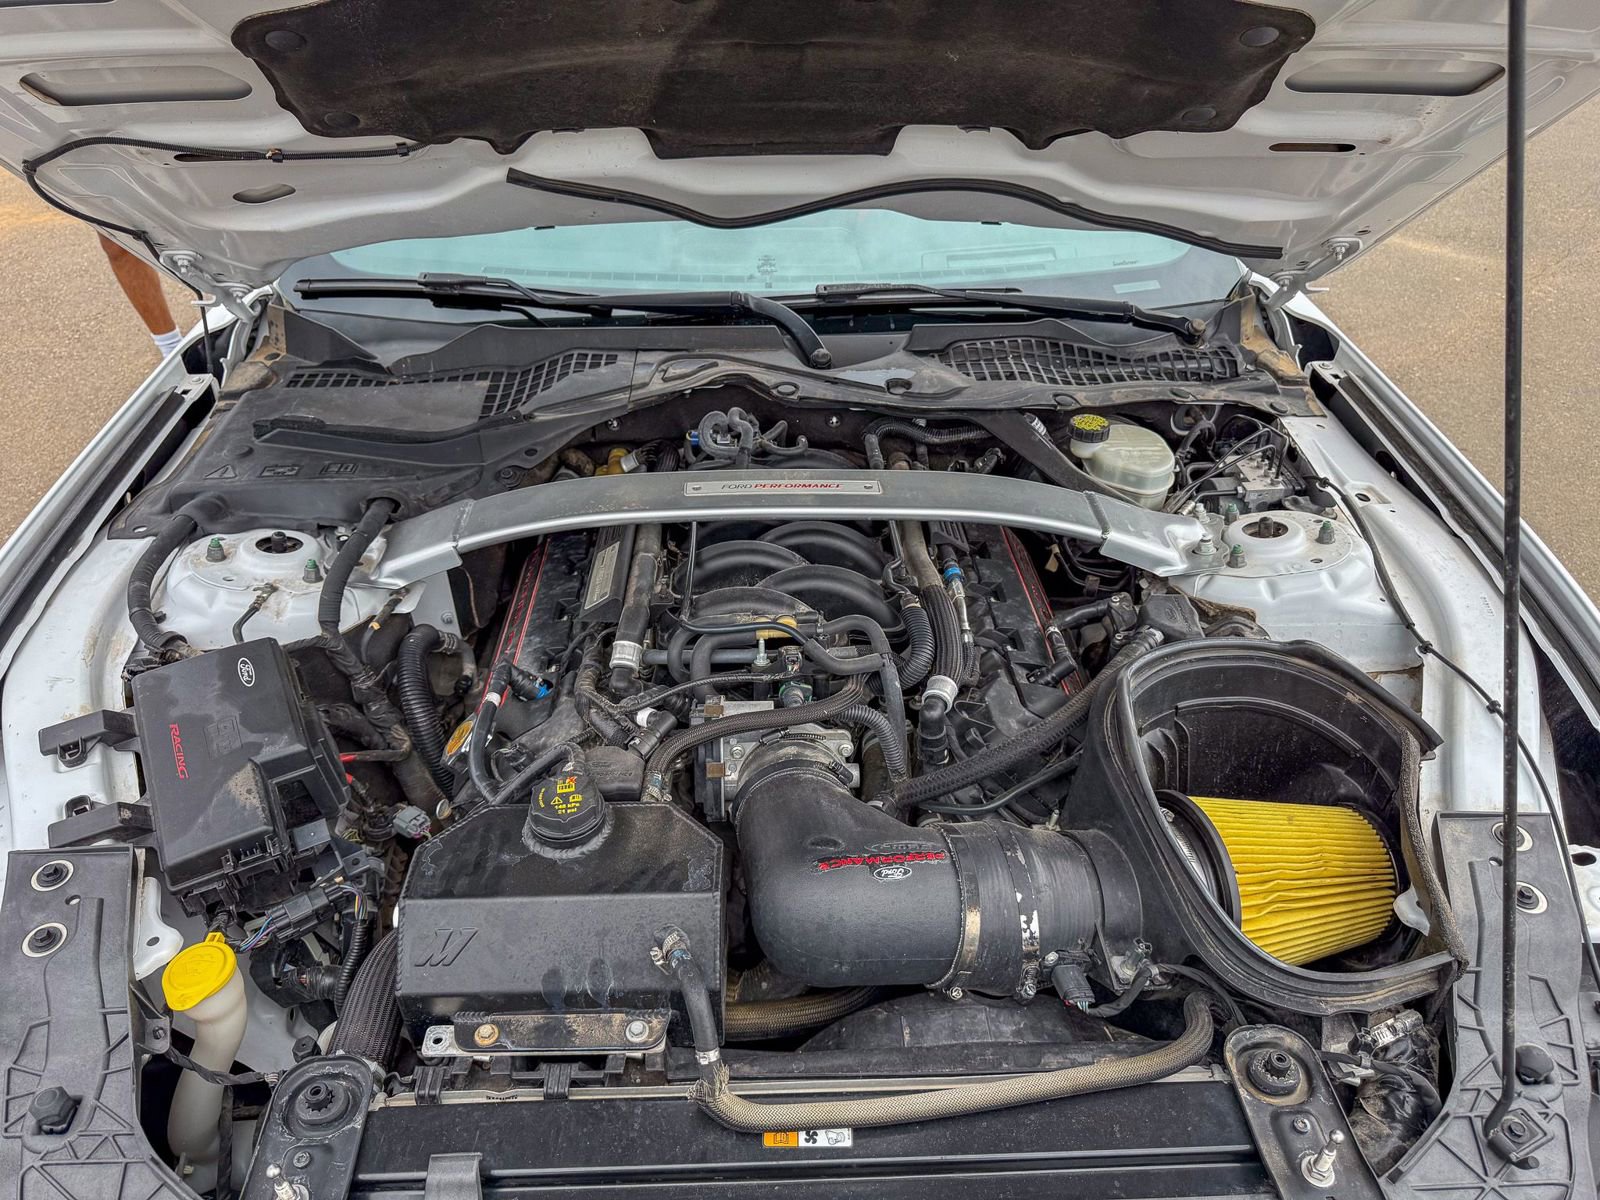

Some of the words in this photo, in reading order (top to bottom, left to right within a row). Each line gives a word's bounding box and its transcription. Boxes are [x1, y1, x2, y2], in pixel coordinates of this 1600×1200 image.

[239, 661, 253, 683] Ford
[169, 722, 190, 780] RACING
[818, 851, 946, 870] PERFORMANCE
[879, 866, 907, 879] Ford
